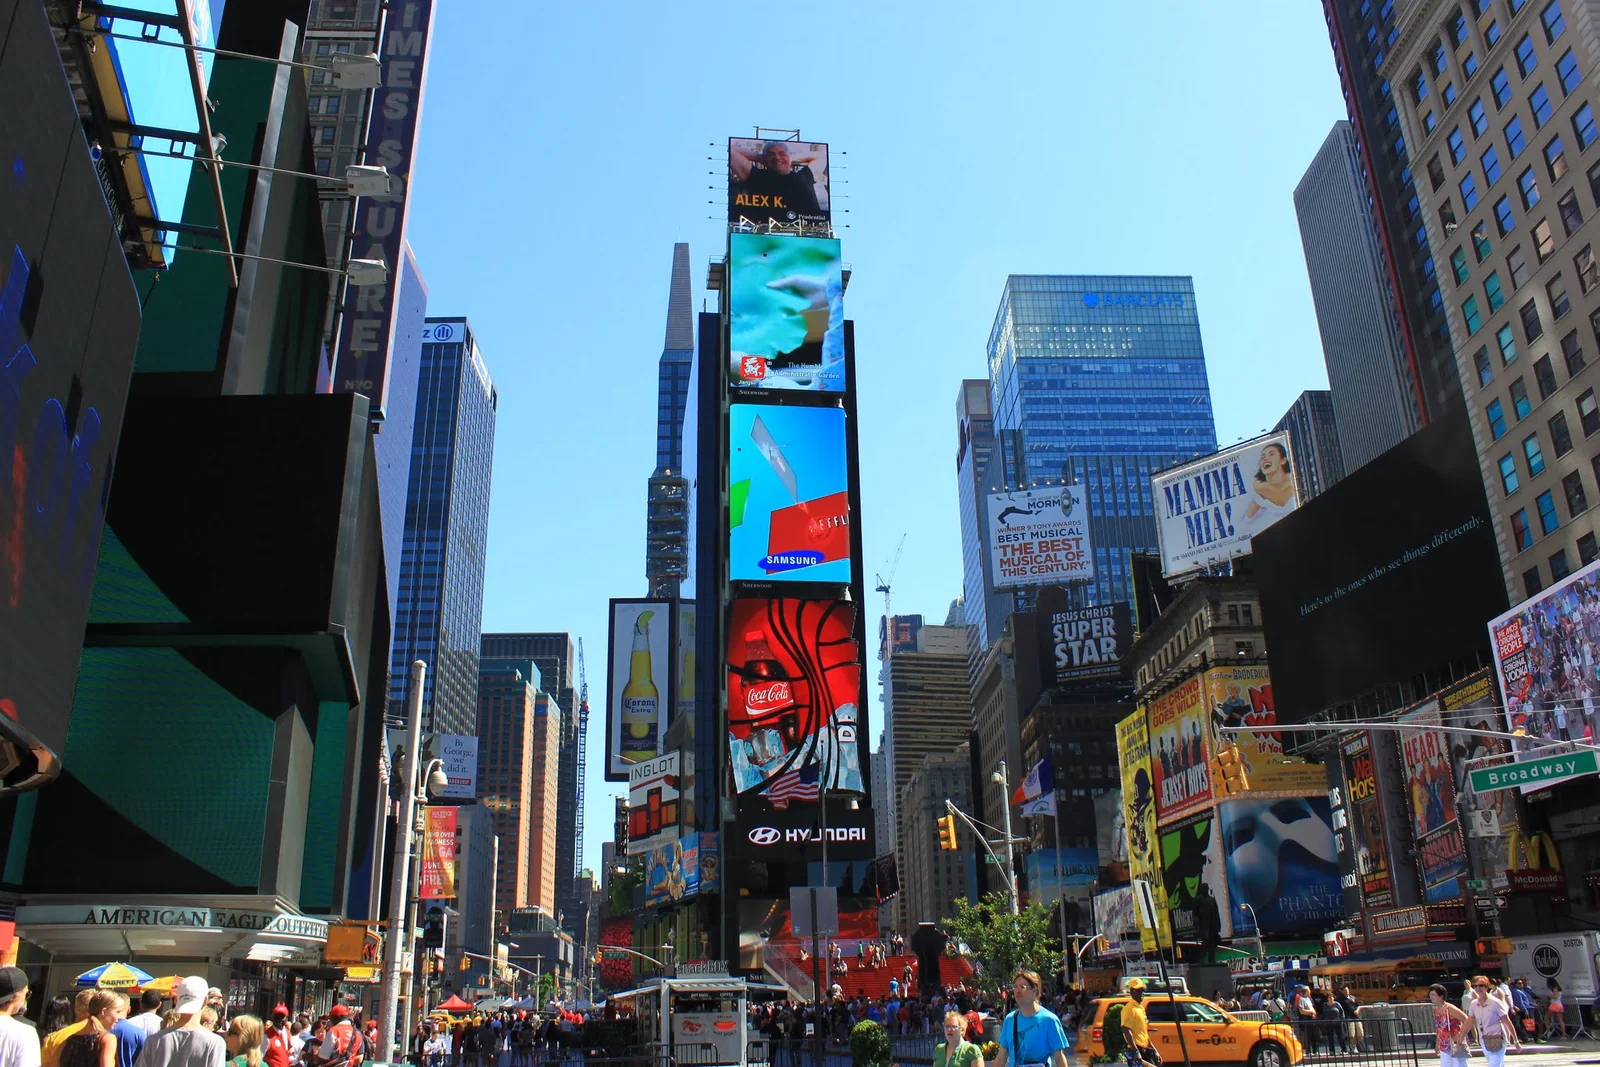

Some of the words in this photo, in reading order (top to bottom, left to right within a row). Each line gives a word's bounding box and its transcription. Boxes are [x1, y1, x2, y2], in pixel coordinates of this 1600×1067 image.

[735, 193, 769, 207] ALEX
[773, 196, 787, 208] K.
[1103, 292, 1185, 307] BARCLAYS
[787, 361, 800, 369] The
[344, 380, 374, 390] NYC
[1162, 462, 1248, 520] MAMMA
[997, 524, 1026, 534] WINNER
[1052, 520, 1082, 528] AWARDS
[1183, 501, 1236, 550] MIA!
[997, 532, 1026, 543] BEST
[1030, 527, 1083, 540] MUSICAL
[1037, 536, 1083, 553] BEST
[766, 555, 818, 566] SAMSUNG
[999, 553, 1062, 569] MUSICAL
[1064, 550, 1085, 561] OF
[1324, 594, 1333, 605] to
[1333, 587, 1347, 600] the
[1347, 576, 1367, 592] ones
[1367, 567, 1386, 581] who
[1387, 558, 1401, 572] see
[1402, 544, 1430, 563] things
[1431, 515, 1485, 549] differently.
[1000, 566, 1027, 578] THIS
[1051, 611, 1079, 624] JESUS
[1080, 606, 1115, 619] CHRIST
[1052, 617, 1117, 644] SUPER
[1505, 622, 1518, 635] MOST
[1498, 630, 1521, 647] ORIGINAL
[1054, 636, 1122, 669] STAR
[1500, 637, 1523, 657] PEOPLE
[1505, 665, 1529, 684] VODKA
[747, 682, 789, 706] Coca-Cola
[1150, 700, 1167, 716] THE
[1168, 678, 1199, 707] CROWD
[625, 696, 656, 709] Corona
[1152, 711, 1175, 728] GOES
[1176, 691, 1201, 715] WILD!
[455, 738, 464, 748] By
[1258, 741, 1267, 753] If
[1403, 731, 1441, 768] HEART
[444, 746, 474, 758] George,
[447, 764, 460, 773] did
[460, 764, 469, 773] it.
[630, 756, 675, 782] INGLOT
[1488, 760, 1576, 785] Broadway
[1161, 773, 1188, 809] JERSEY
[1187, 761, 1209, 797] BOYS
[785, 827, 866, 842] HYUNDAI
[443, 861, 453, 869] 20
[1514, 875, 1564, 884] McDonald's
[1308, 885, 1329, 895] THE
[84, 907, 208, 927] AMERICAN
[216, 911, 273, 930] EAGLE
[275, 916, 328, 938] OUTFITTE
[1285, 911, 1299, 921] OF
[1301, 910, 1321, 920] THE
[1377, 911, 1409, 931] OUTRAGEOUS
[1518, 941, 1529, 950] YORK
[1563, 938, 1584, 948] BOSTON
[1437, 949, 1469, 961] EXCHANGE
[676, 959, 730, 975] snackBOX
[100, 978, 135, 987] SABRETT
[1085, 979, 1113, 988] GIFTS
